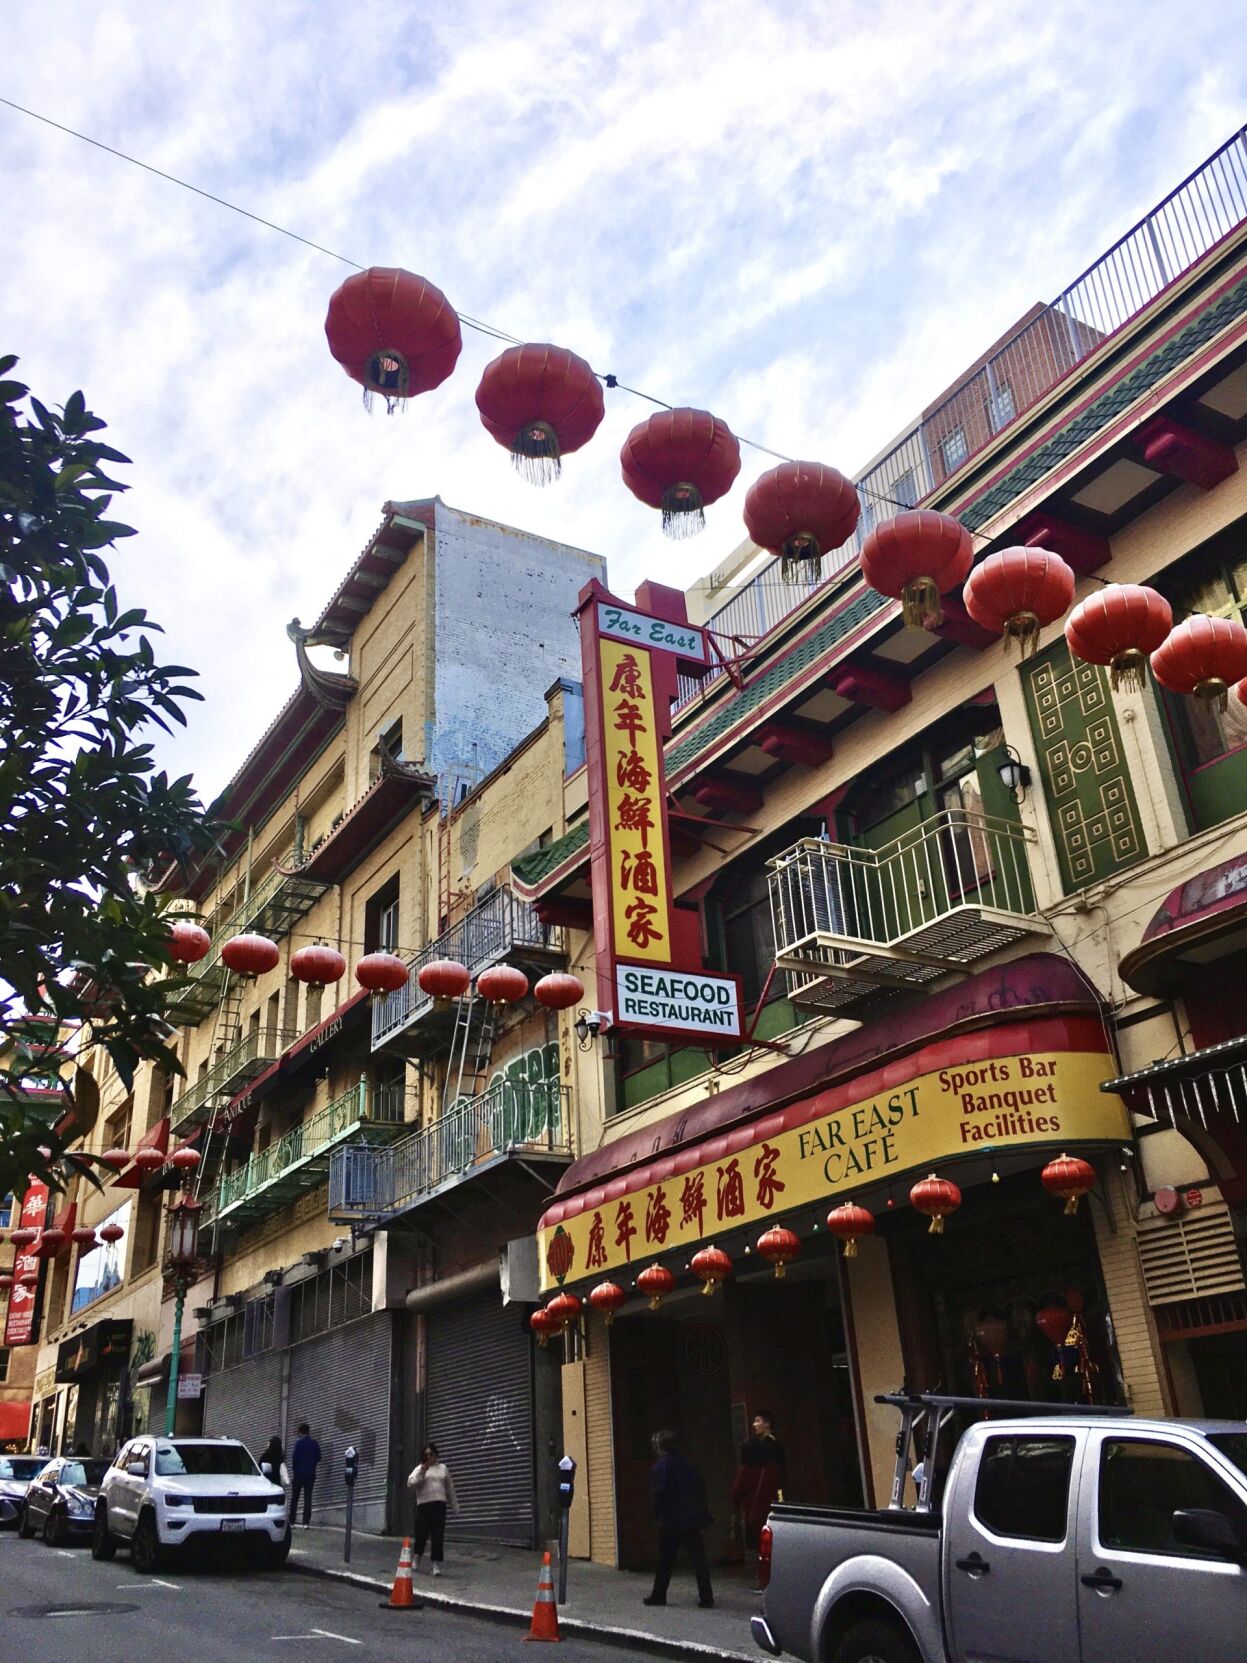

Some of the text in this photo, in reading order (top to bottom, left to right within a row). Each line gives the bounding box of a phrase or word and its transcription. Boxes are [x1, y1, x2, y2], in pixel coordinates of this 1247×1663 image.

[604, 609, 696, 651] Far East
[608, 653, 664, 950] 康年海鮮酒家
[624, 972, 731, 1006] SEAFOOD
[624, 998, 734, 1027] RESTAURANT
[309, 1016, 343, 1053] GALLERY
[938, 1057, 1058, 1096] Sports Bar
[961, 1083, 1058, 1115] Banquet
[798, 1086, 921, 1160] FAR EAST
[959, 1110, 1062, 1144] Facilities
[823, 1125, 899, 1185] CAFÉ
[585, 1143, 786, 1269] 康年海鮮酒家
